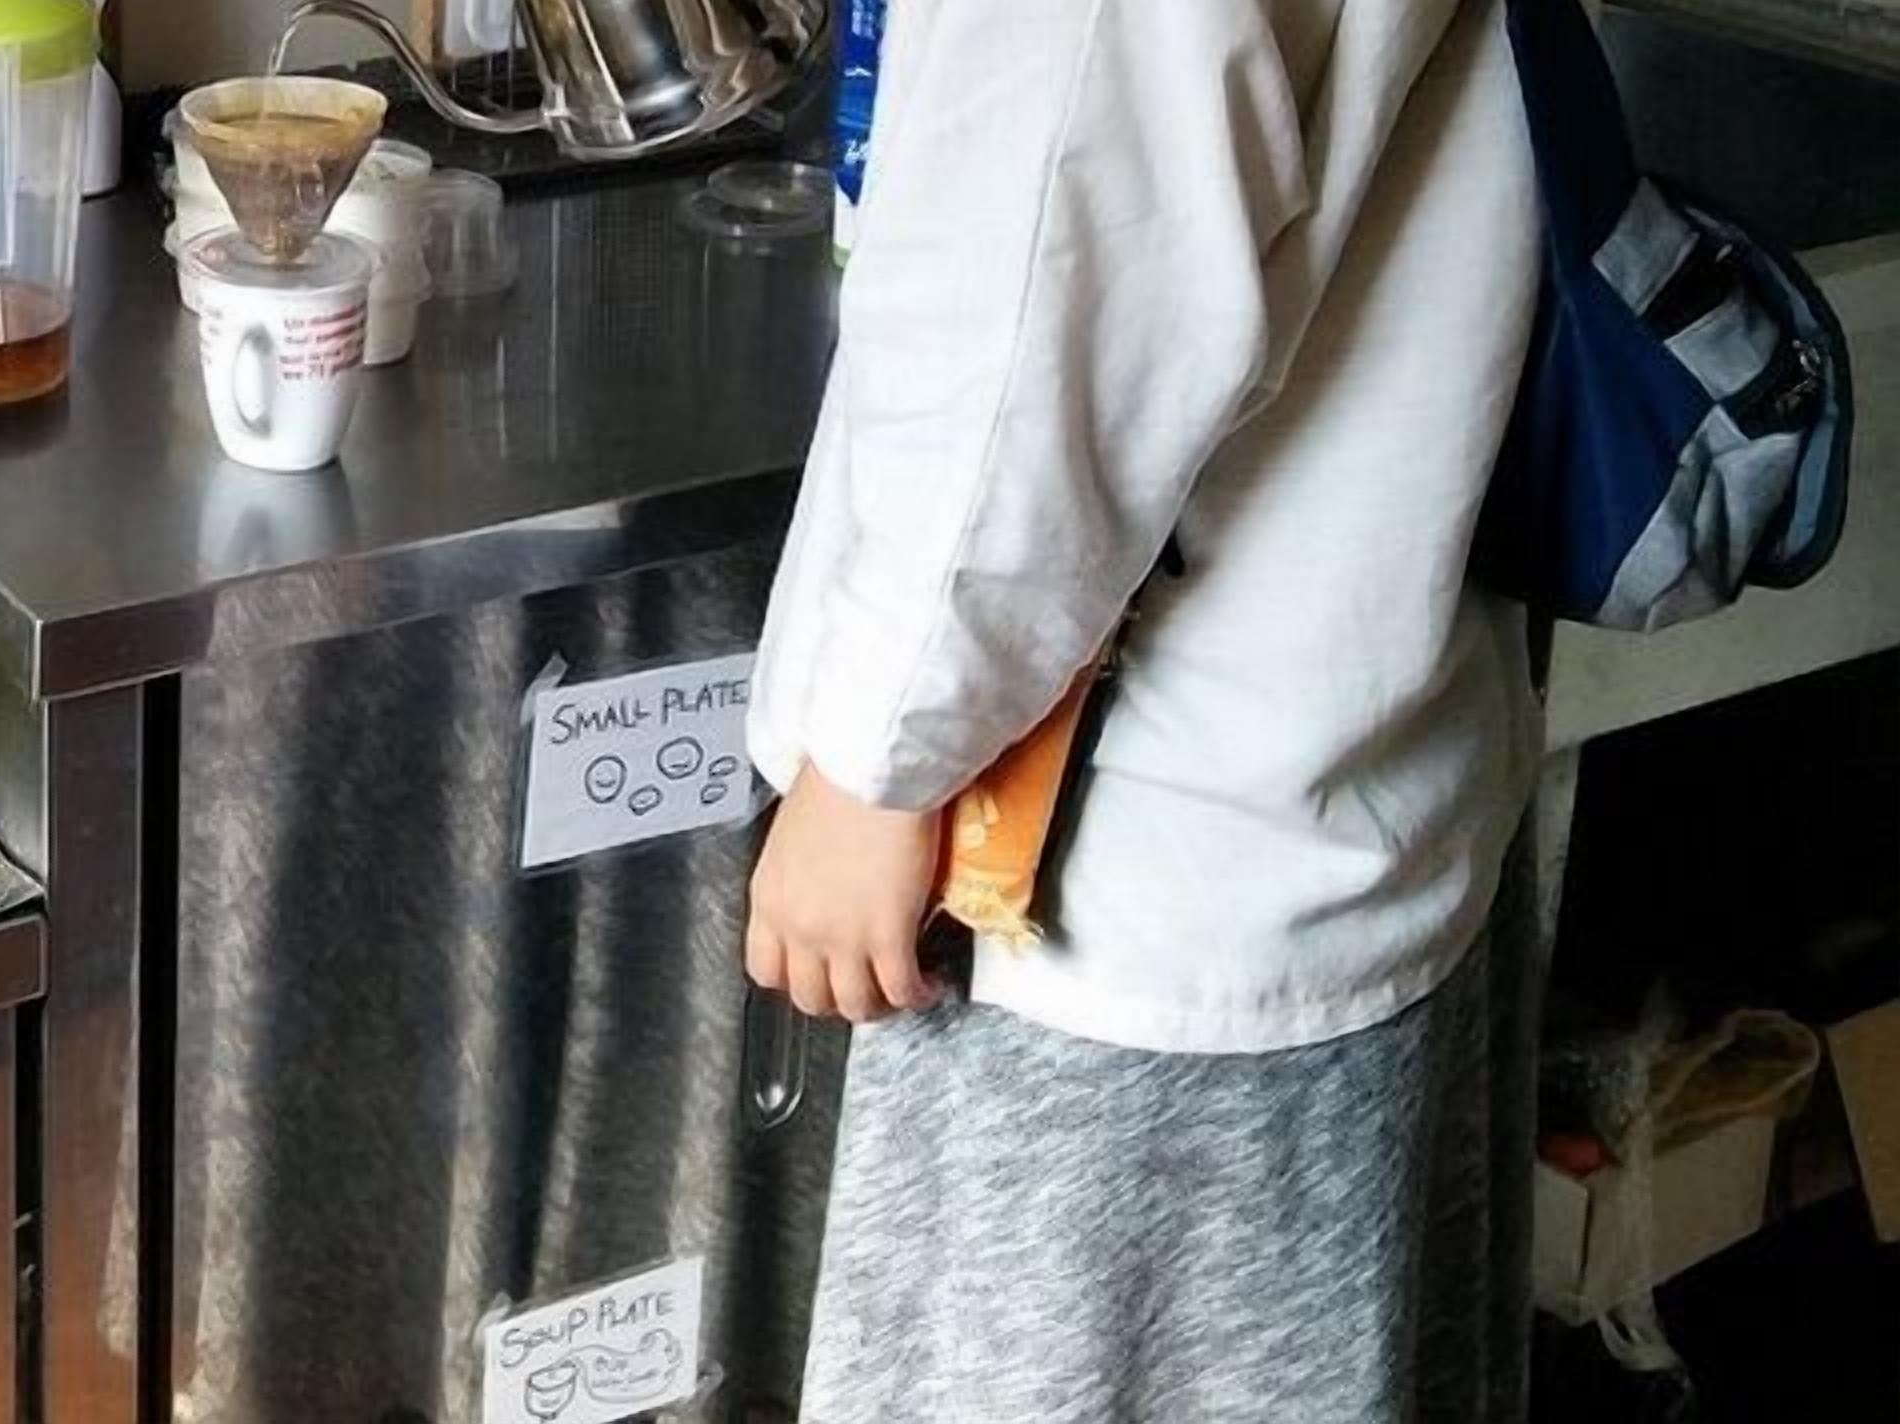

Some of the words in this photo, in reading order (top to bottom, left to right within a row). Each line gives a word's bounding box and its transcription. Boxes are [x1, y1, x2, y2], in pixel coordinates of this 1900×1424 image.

[551, 697, 651, 745] SMALL
[661, 678, 749, 725] PLATE
[501, 1308, 588, 1368] SOUP
[596, 1291, 674, 1332] PLATE
